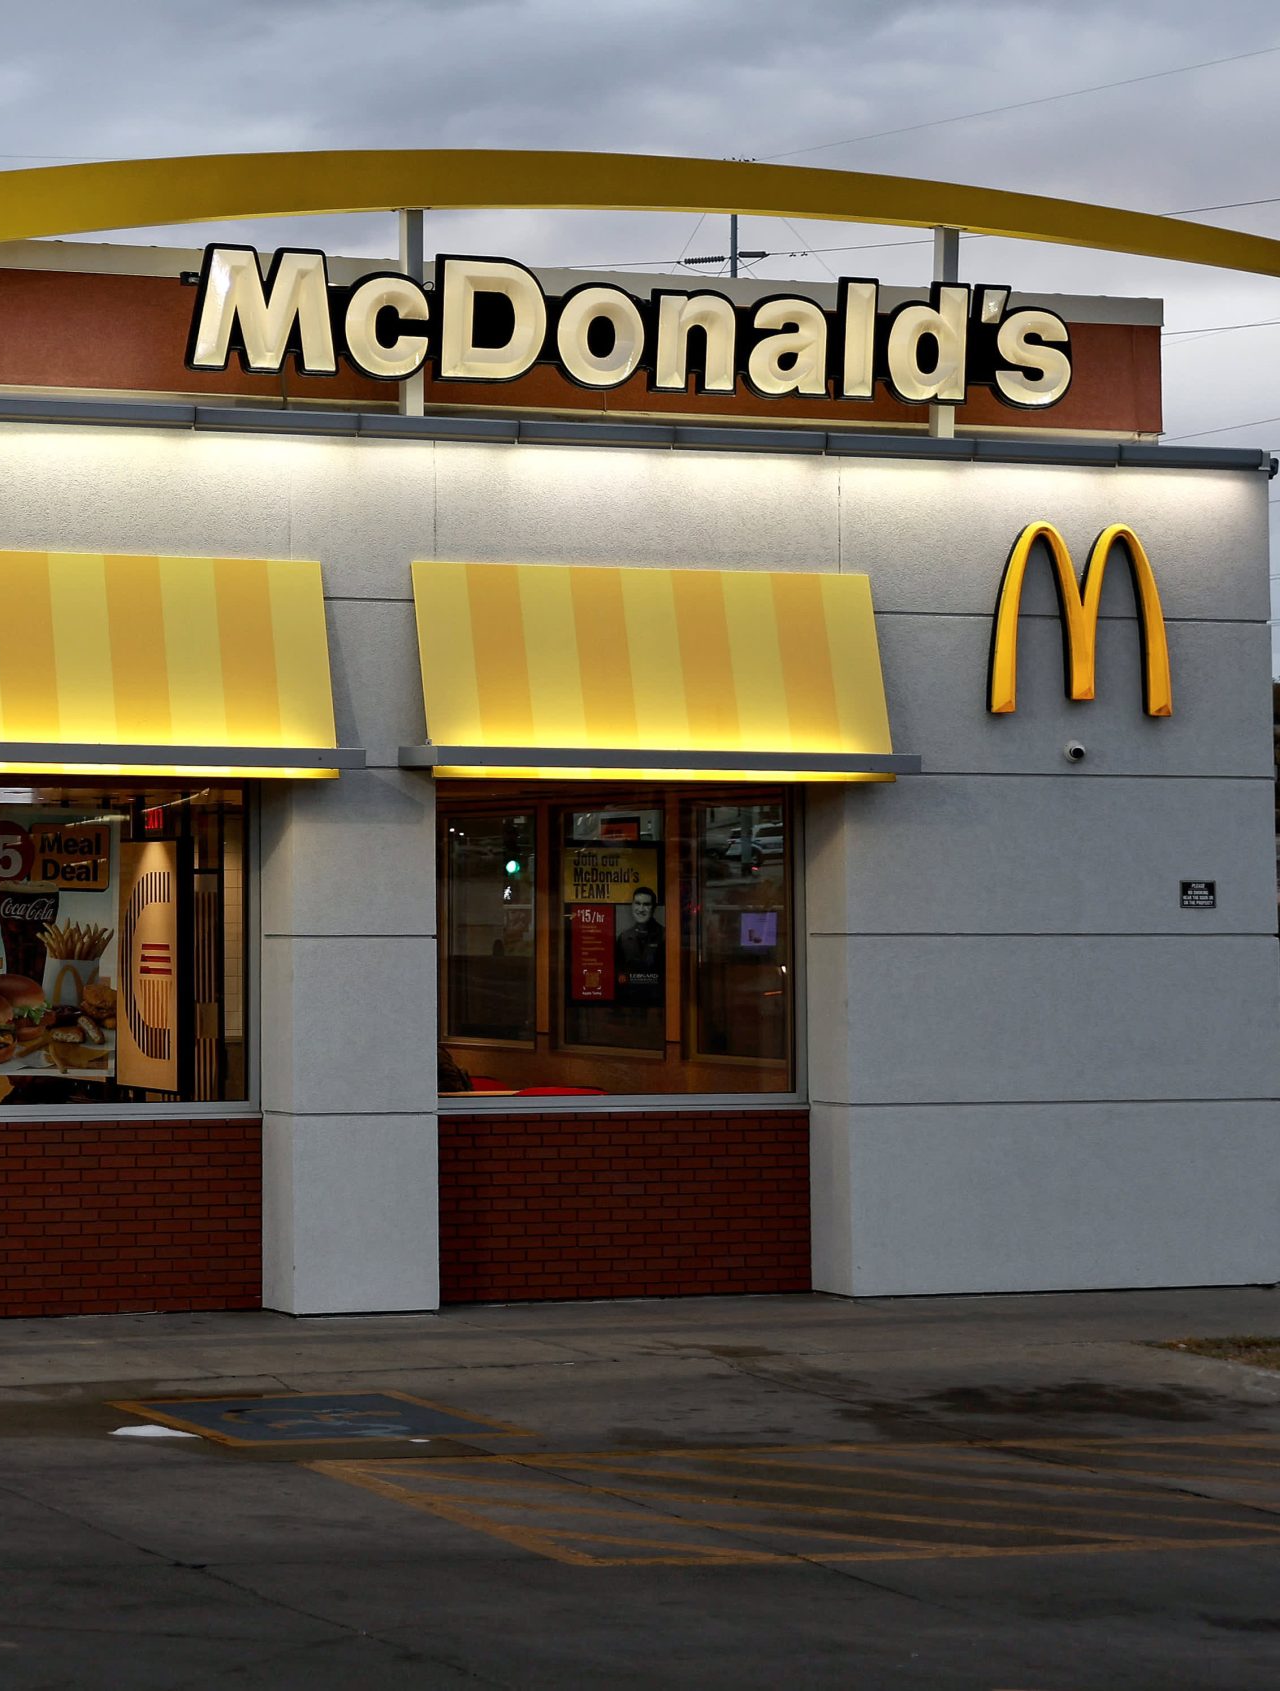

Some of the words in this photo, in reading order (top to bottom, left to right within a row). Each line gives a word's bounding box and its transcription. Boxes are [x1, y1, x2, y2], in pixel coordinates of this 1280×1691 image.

[185, 242, 1074, 410] McDonald's
[39, 831, 101, 855] Meal
[41, 858, 99, 882] Deal
[573, 851, 598, 867] Join
[601, 855, 620, 867] our
[573, 867, 640, 883] McDonald's
[573, 884, 610, 899] TEAM!
[0, 897, 55, 920] Coca-Cola
